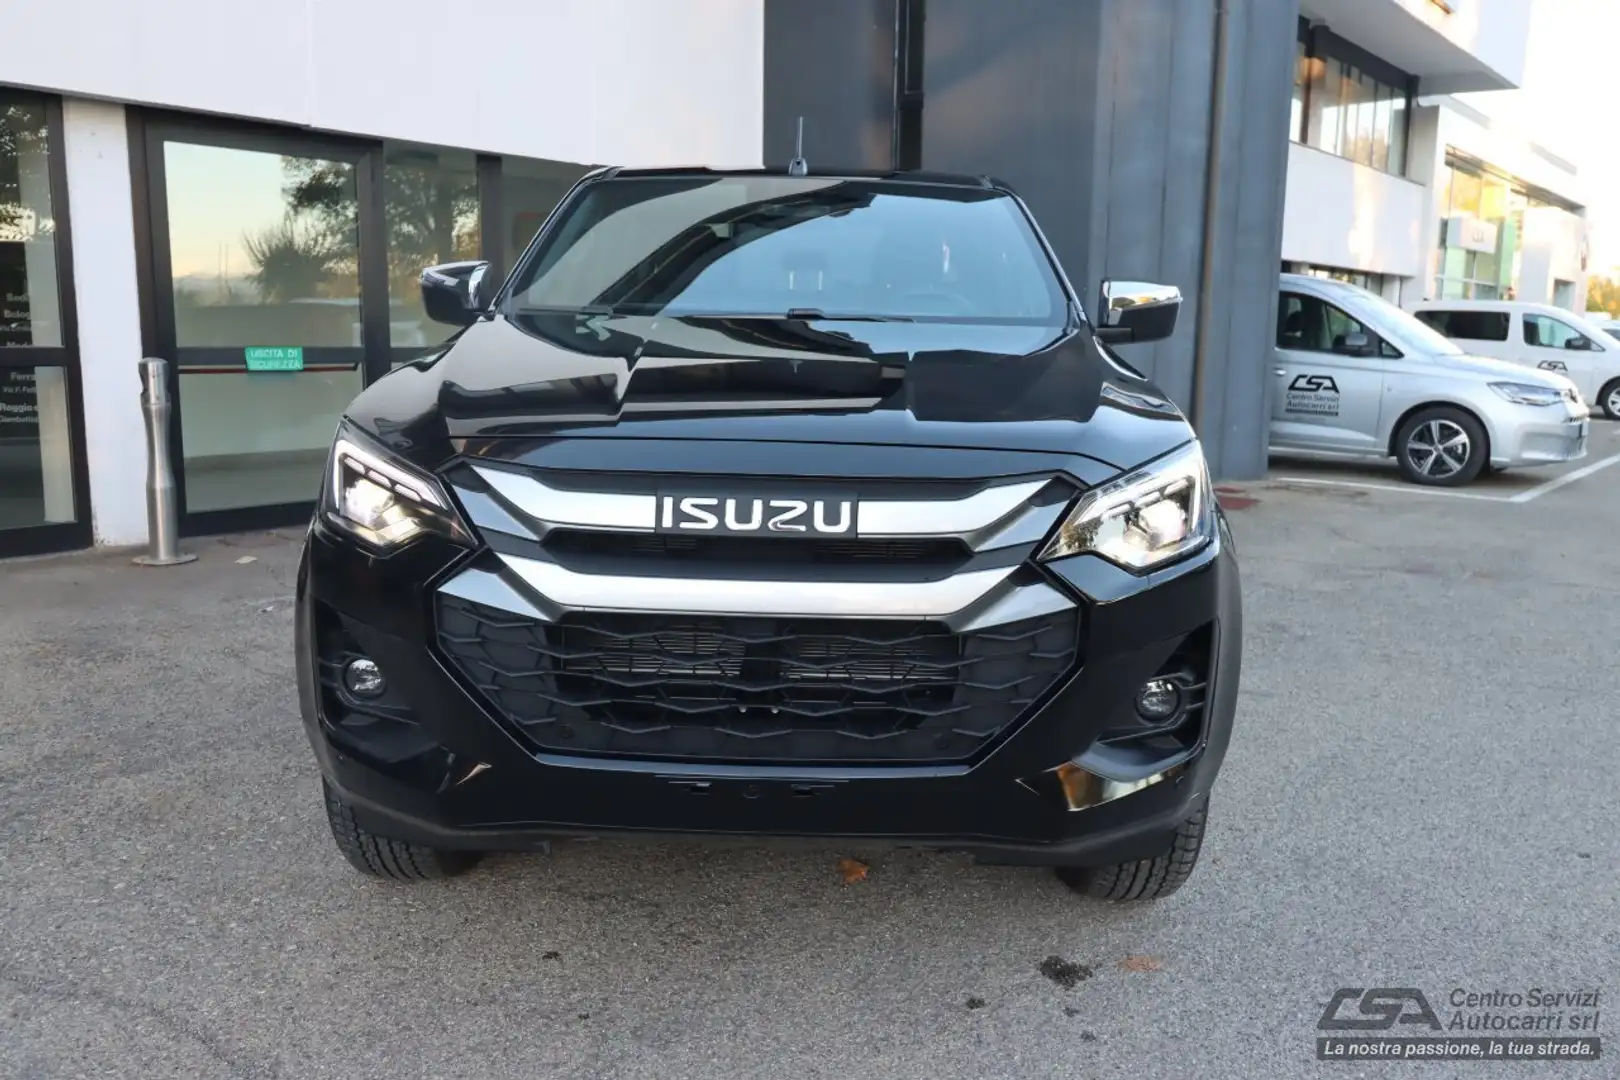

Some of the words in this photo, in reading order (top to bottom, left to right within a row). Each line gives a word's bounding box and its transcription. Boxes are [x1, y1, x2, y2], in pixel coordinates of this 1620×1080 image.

[250, 349, 284, 358] USCITA
[287, 349, 298, 358] DI
[1288, 374, 1340, 393] CSA
[661, 496, 851, 533] ISUZU
